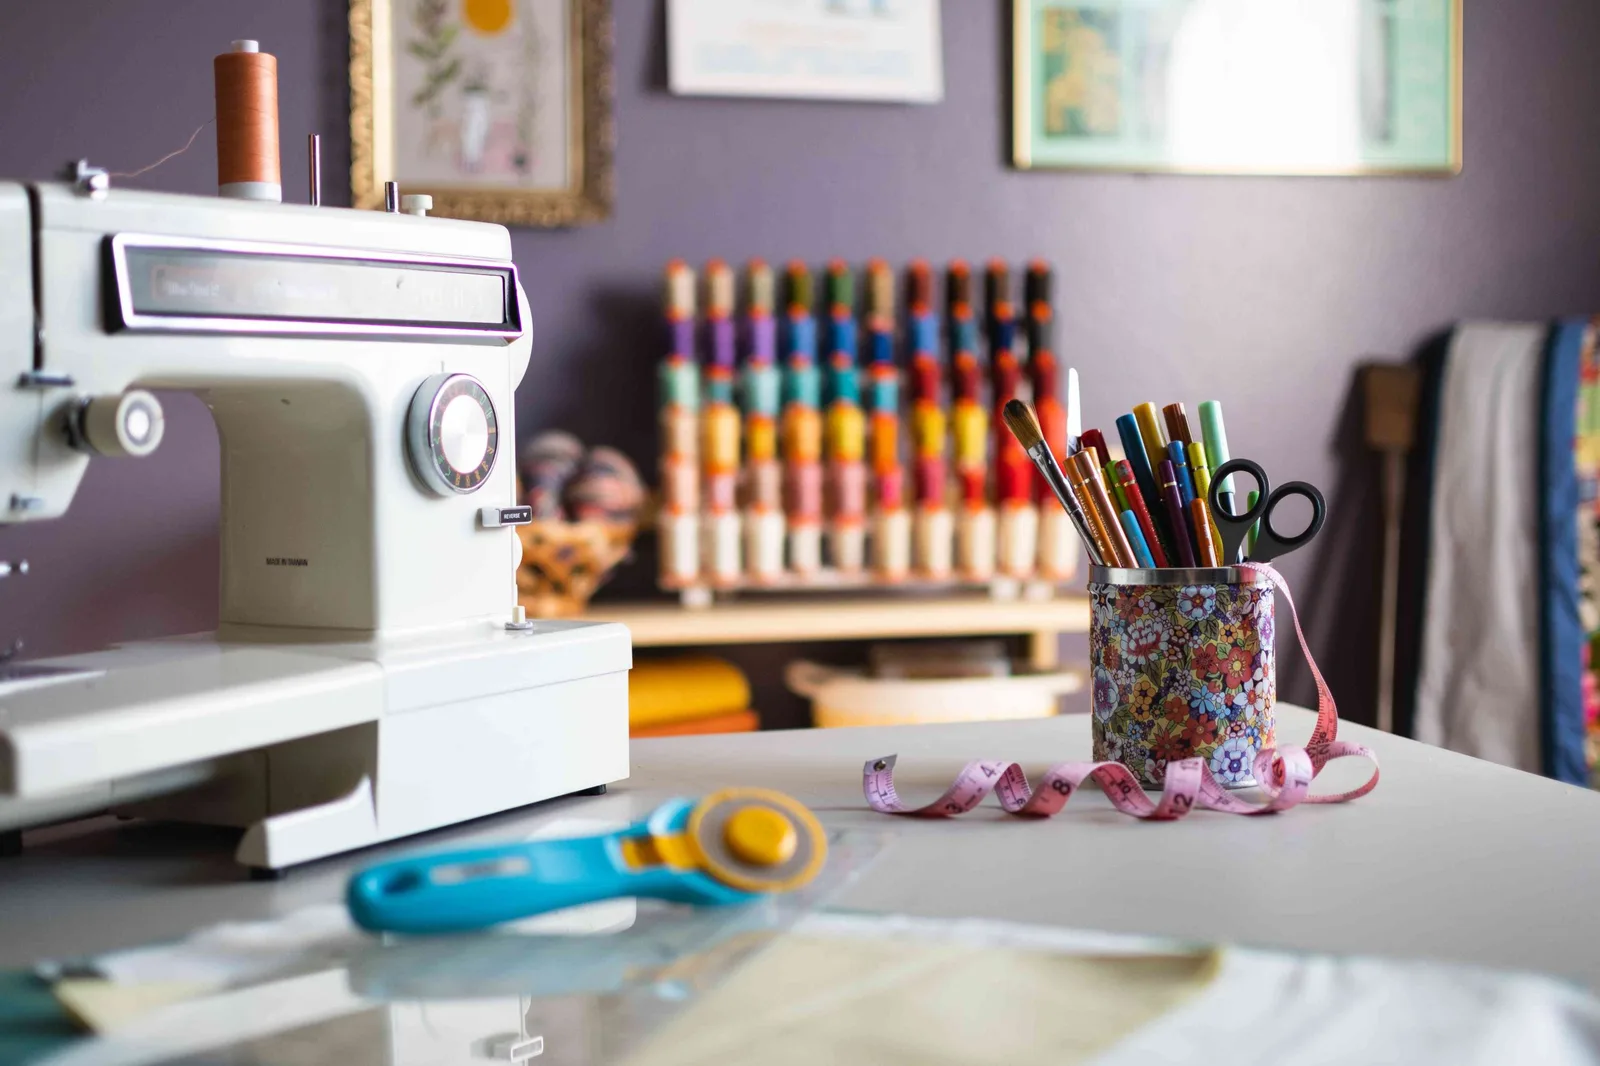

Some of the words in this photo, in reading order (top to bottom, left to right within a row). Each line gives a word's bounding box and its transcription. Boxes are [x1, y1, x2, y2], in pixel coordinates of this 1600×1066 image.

[265, 557, 281, 566] MADE
[281, 558, 287, 566] IN
[287, 558, 309, 567] TAIWAN
[980, 765, 997, 778] 4
[1052, 779, 1071, 796] 8
[1116, 778, 1132, 794] 10
